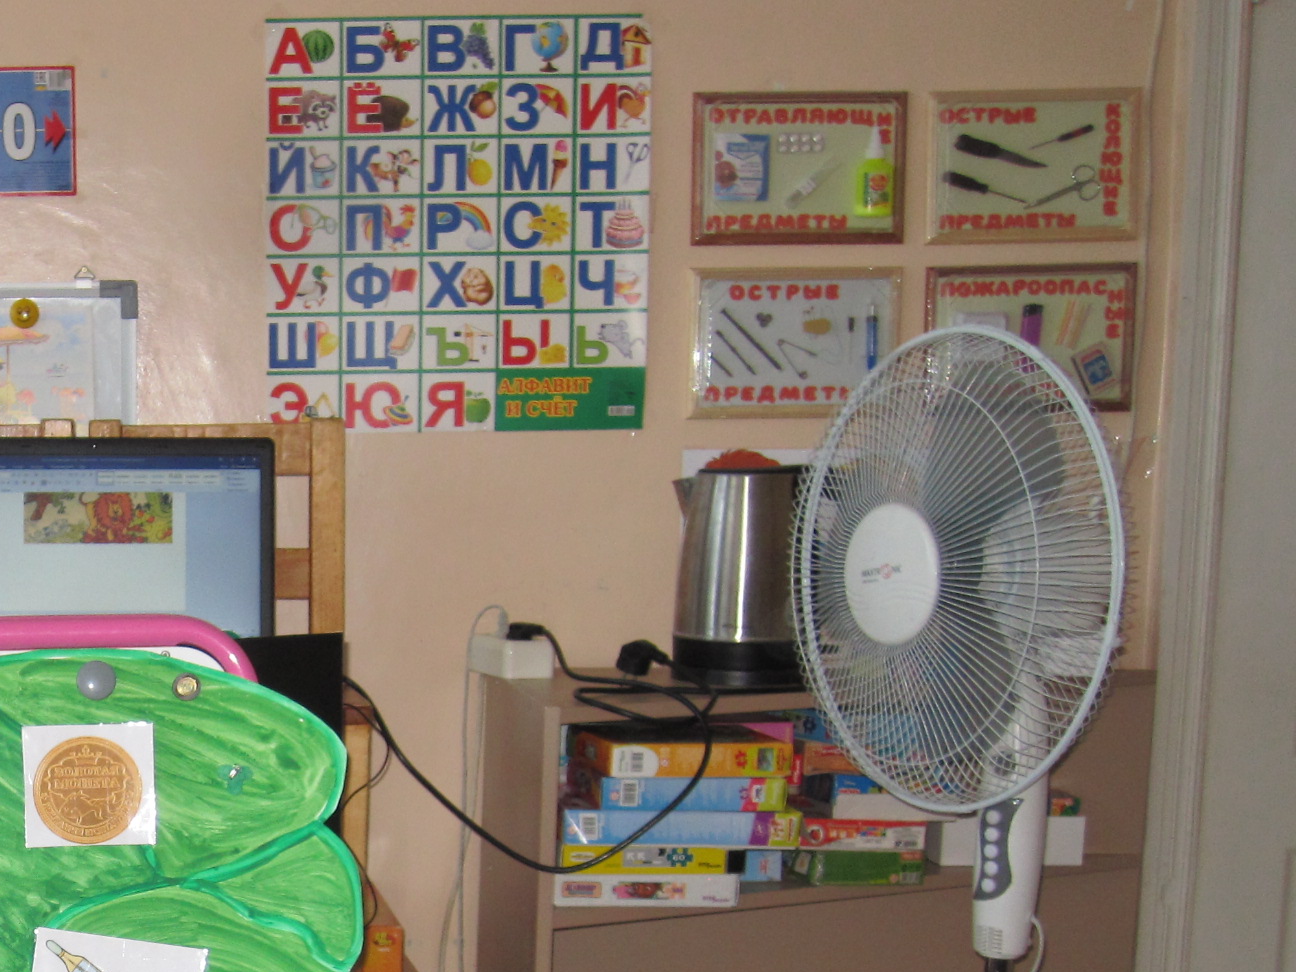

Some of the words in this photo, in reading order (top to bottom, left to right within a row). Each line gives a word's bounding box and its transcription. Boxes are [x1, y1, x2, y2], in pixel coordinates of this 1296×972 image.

[269, 27, 314, 75] А
[346, 25, 385, 73] Б
[428, 25, 467, 72] В
[505, 24, 536, 72] Г
[580, 23, 624, 70] Д
[269, 87, 303, 134] Е
[347, 83, 381, 134] Ё
[427, 84, 477, 132] Ж
[505, 83, 539, 131] З
[580, 83, 617, 130] И
[939, 107, 1037, 125] ОСТРЫЕ
[269, 142, 303, 194] Й
[346, 145, 380, 192] К
[427, 144, 467, 192] Л
[505, 143, 547, 190] М
[580, 142, 616, 190] Н
[346, 204, 382, 251] П
[427, 202, 462, 250] Р
[504, 201, 542, 249] С
[580, 202, 615, 248] Т
[706, 213, 847, 231] ПРЕДМЕТЫ
[939, 212, 1076, 230] ПРЕДМЕТЫ
[270, 263, 308, 310] У
[347, 262, 390, 309] Ф
[426, 261, 467, 308] Х
[504, 260, 544, 309] Ц
[578, 259, 615, 306] Ч
[729, 284, 840, 300] ОСТРЫЕ
[269, 322, 316, 369] Ш
[346, 321, 397, 369] Щ
[426, 327, 469, 367] Ъ
[502, 320, 550, 366] Ы
[577, 325, 608, 365] Ь
[270, 382, 309, 424] Э
[345, 382, 401, 428] Ю
[424, 381, 465, 427] Я
[497, 377, 593, 395] АЛФАВИТ
[505, 401, 522, 417] И
[526, 396, 578, 417] СЧЁТ
